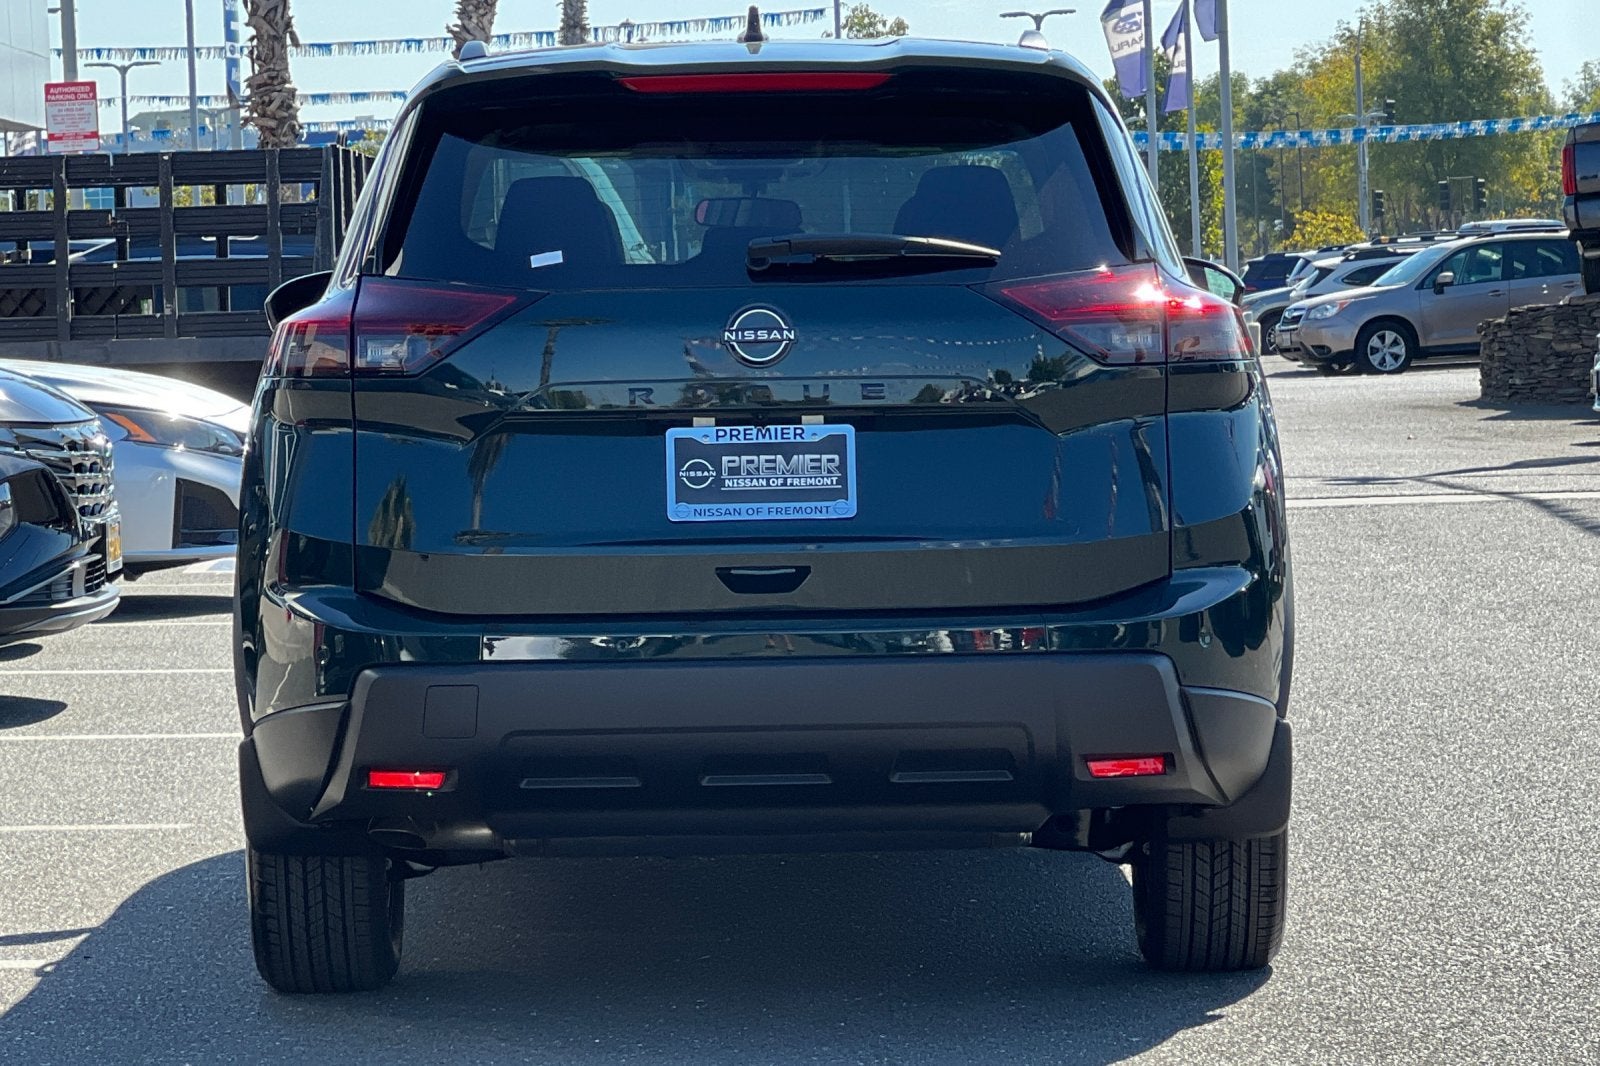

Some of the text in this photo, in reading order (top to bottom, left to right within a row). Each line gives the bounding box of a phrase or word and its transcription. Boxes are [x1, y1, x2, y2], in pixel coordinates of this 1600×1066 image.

[49, 86, 90, 94] AUTHORIZED
[47, 92, 94, 101] PARKING ONLY
[724, 329, 795, 341] NISSAN
[628, 383, 886, 405] RUE
[715, 427, 805, 442] PREMIER
[721, 454, 840, 476] PREMIER
[679, 469, 717, 477] NISSAN
[725, 476, 838, 487] NISSAN OF FREMONT
[693, 505, 832, 517] NISSAN OF FREMONT
